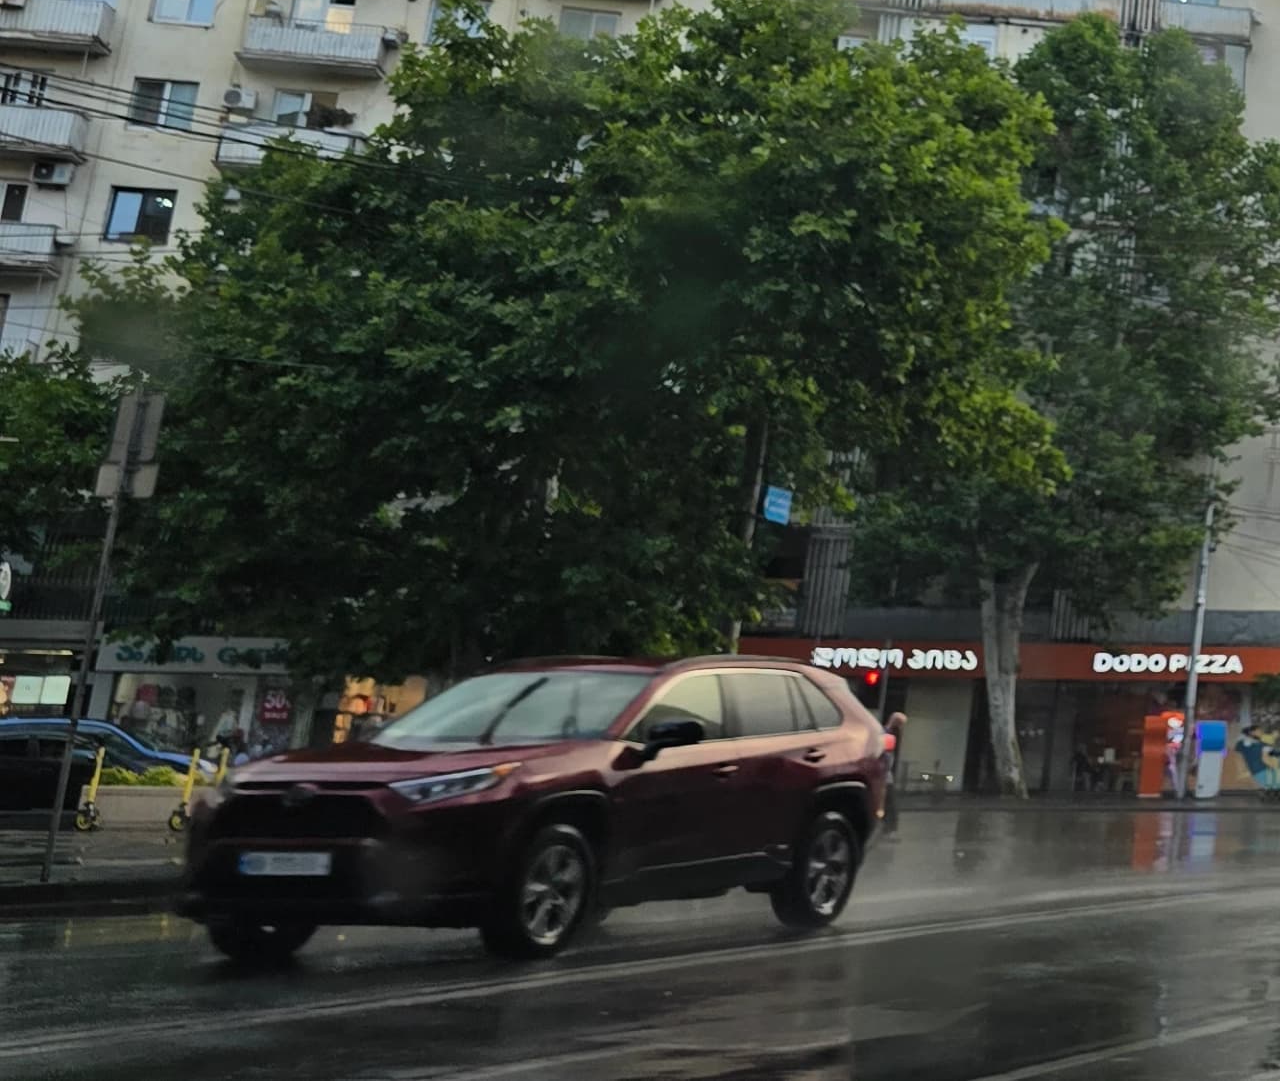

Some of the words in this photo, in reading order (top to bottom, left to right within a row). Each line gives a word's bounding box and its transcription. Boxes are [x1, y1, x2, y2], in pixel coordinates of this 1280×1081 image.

[812, 646, 903, 670] დოდო
[906, 647, 978, 671] პიცა
[1092, 651, 1167, 673] DODO
